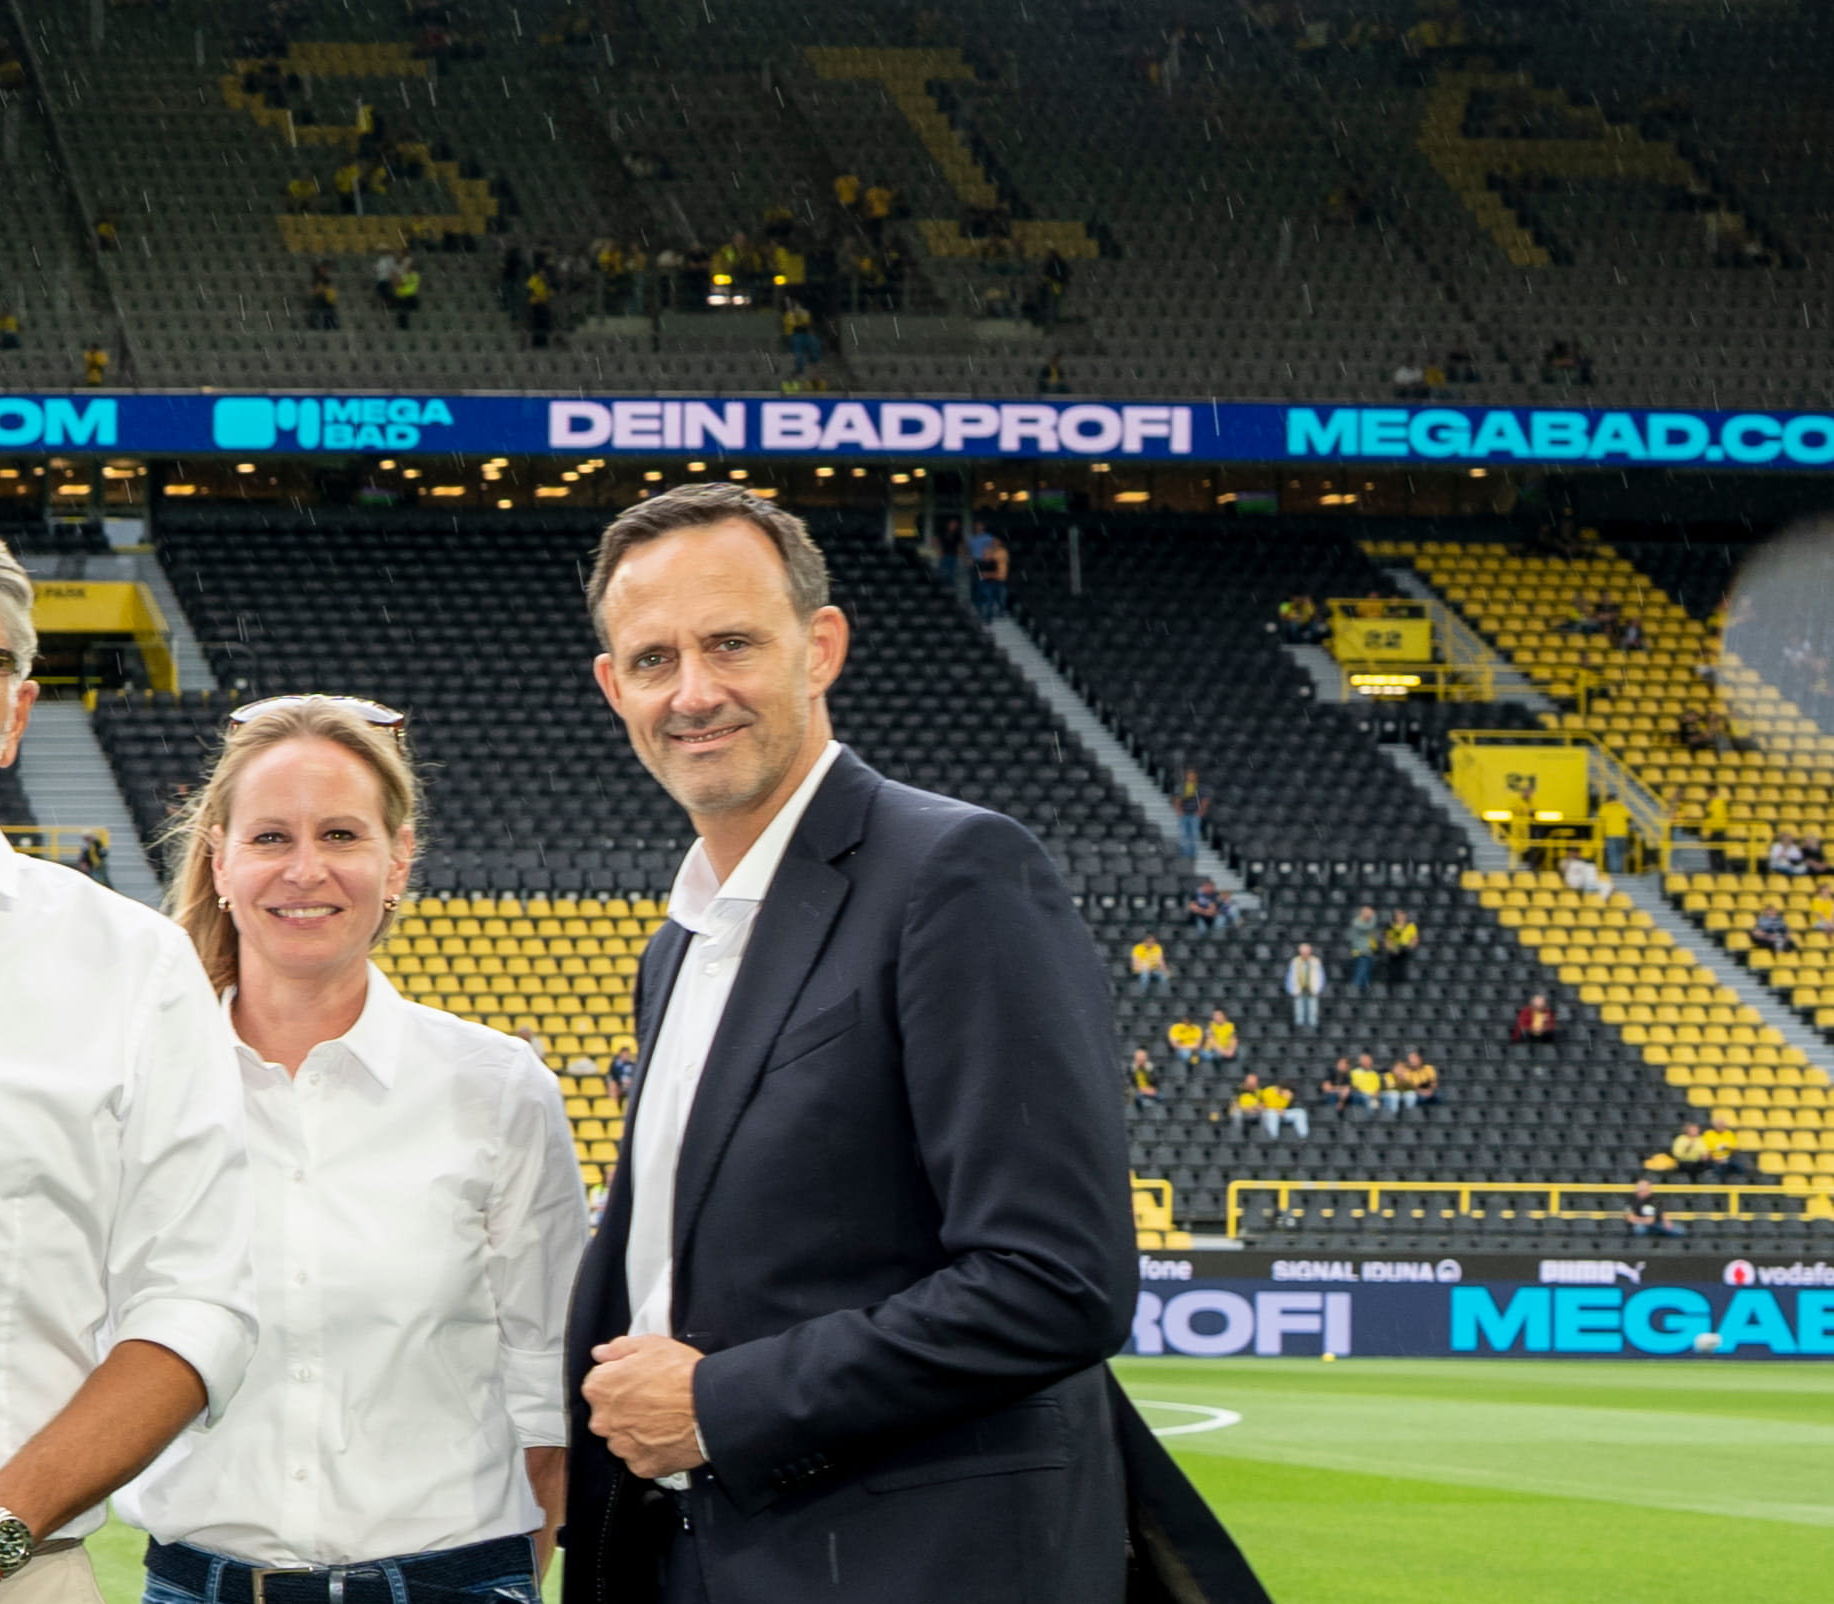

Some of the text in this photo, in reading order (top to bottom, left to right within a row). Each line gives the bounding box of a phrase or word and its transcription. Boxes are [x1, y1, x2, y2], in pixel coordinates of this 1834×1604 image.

[323, 398, 454, 425] MEGA
[323, 424, 420, 450] BAD
[548, 401, 1193, 455] DEIN BADPROFI
[1271, 1260, 1435, 1283] SIGNAL IDUNA
